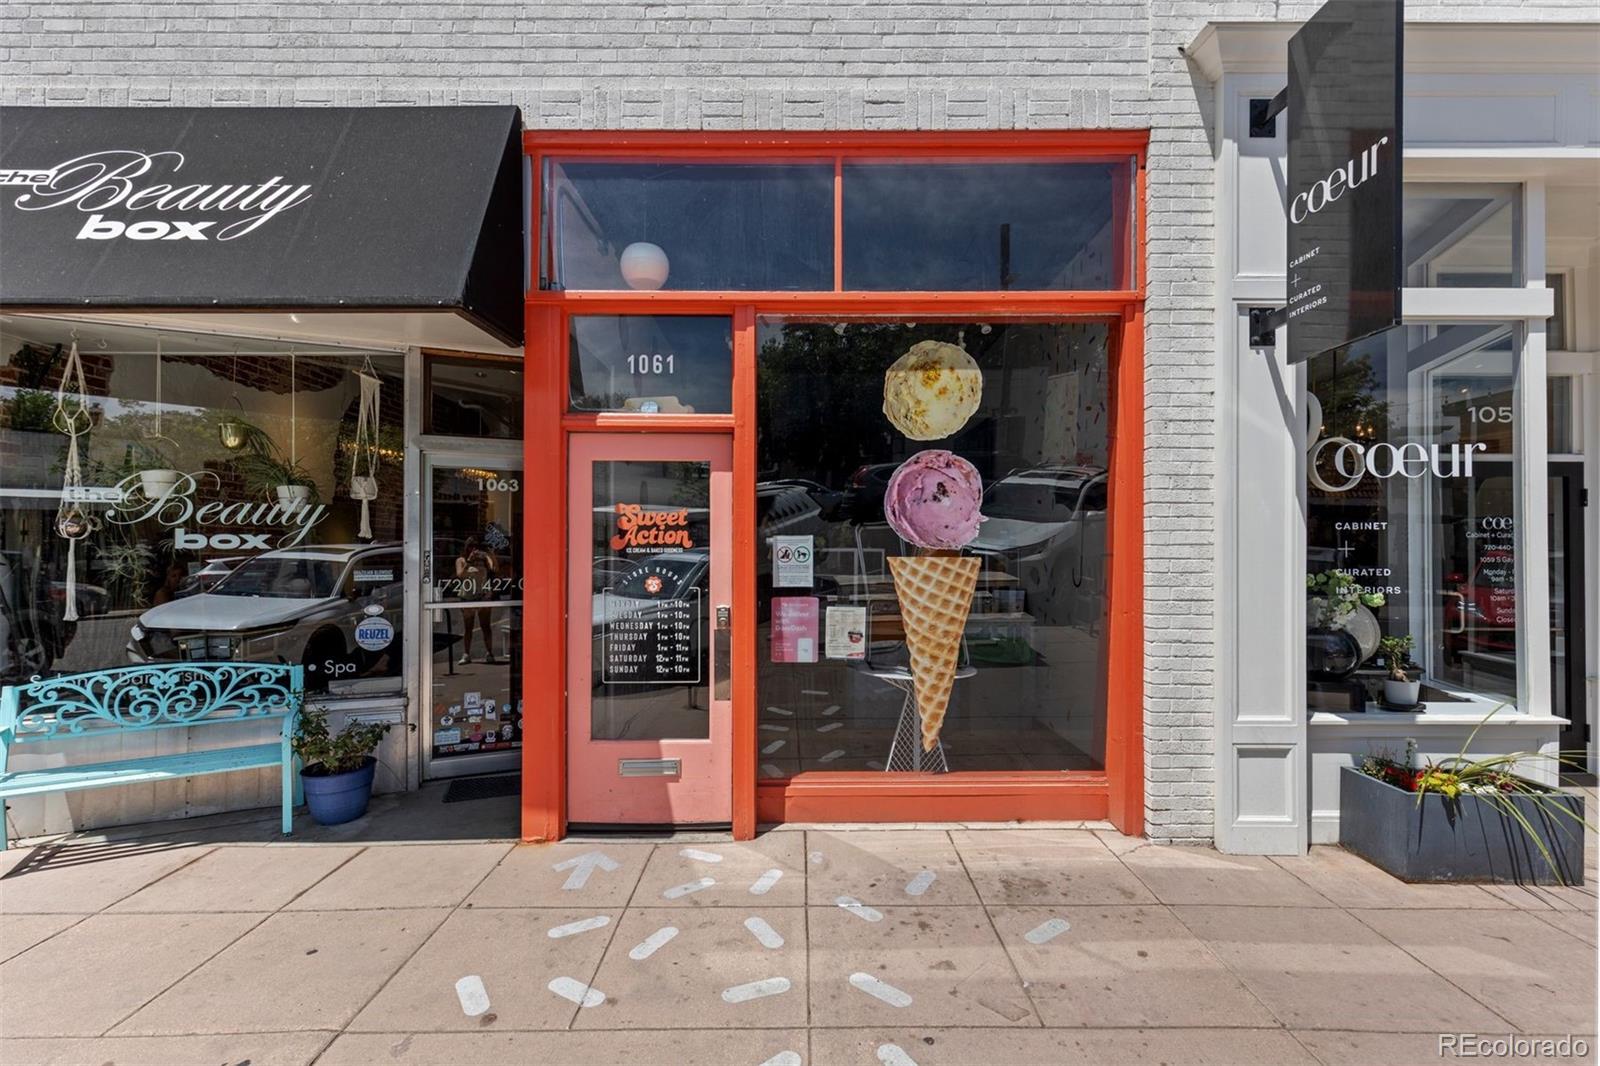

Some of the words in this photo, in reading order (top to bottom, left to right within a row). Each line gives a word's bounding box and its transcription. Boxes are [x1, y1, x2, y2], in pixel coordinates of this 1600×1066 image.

[15, 150, 312, 240] Beauty
[75, 214, 217, 241] box
[1289, 246, 1320, 268] CABINET
[1289, 284, 1322, 304] CURATED
[1289, 296, 1328, 318] INTERIORS
[627, 354, 674, 375] 1061
[1467, 406, 1513, 423] 105
[477, 479, 519, 492] 1063
[105, 469, 330, 550] Beauty
[615, 503, 688, 531] Sweet
[1335, 522, 1388, 530] CABINET
[174, 528, 272, 550] box
[609, 524, 693, 551] Action
[622, 566, 649, 585] STORE
[655, 566, 683, 585] HOURS
[1335, 568, 1391, 576] CURATED
[437, 578, 477, 594] (720)
[1335, 586, 1401, 594] INTERIORS
[609, 611, 642, 619] UESDAY
[358, 628, 390, 640] REUZEL
[609, 622, 653, 630] WEDNESDAY
[609, 633, 648, 641] THURSDAY
[609, 644, 636, 652] FRIDAY
[609, 655, 647, 663] SATURDAY
[30, 673, 89, 691] Son
[118, 668, 229, 688] Barrsh
[324, 660, 356, 678] Spa
[609, 665, 638, 673] SUNDAY
